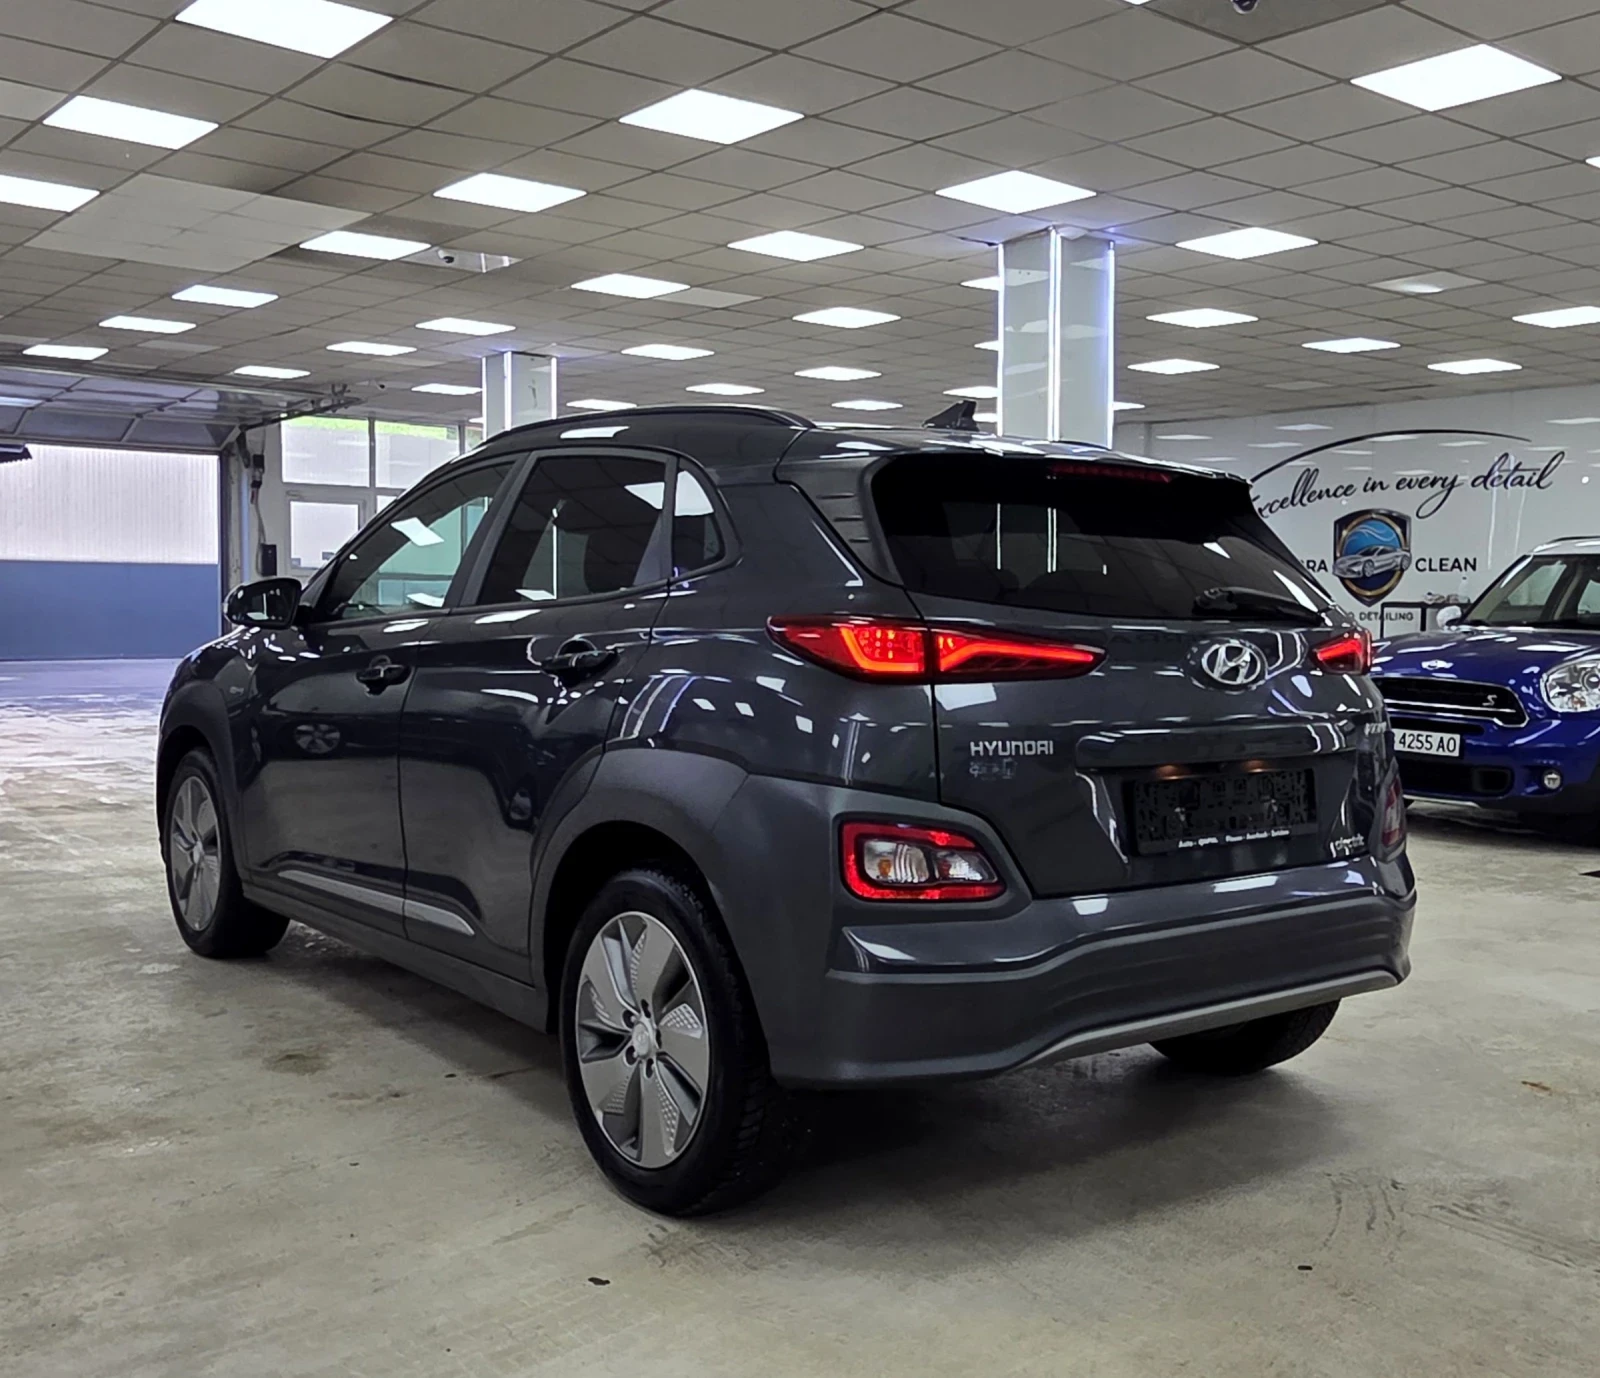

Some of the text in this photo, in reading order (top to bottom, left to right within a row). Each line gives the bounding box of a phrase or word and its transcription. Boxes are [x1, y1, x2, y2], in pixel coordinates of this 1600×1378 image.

[1252, 451, 1565, 519] xcellence in every detail
[1300, 557, 1477, 573] RA CLEAN
[969, 740, 1053, 756] HYUNDAI
[1398, 732, 1457, 753] 4255 AO
